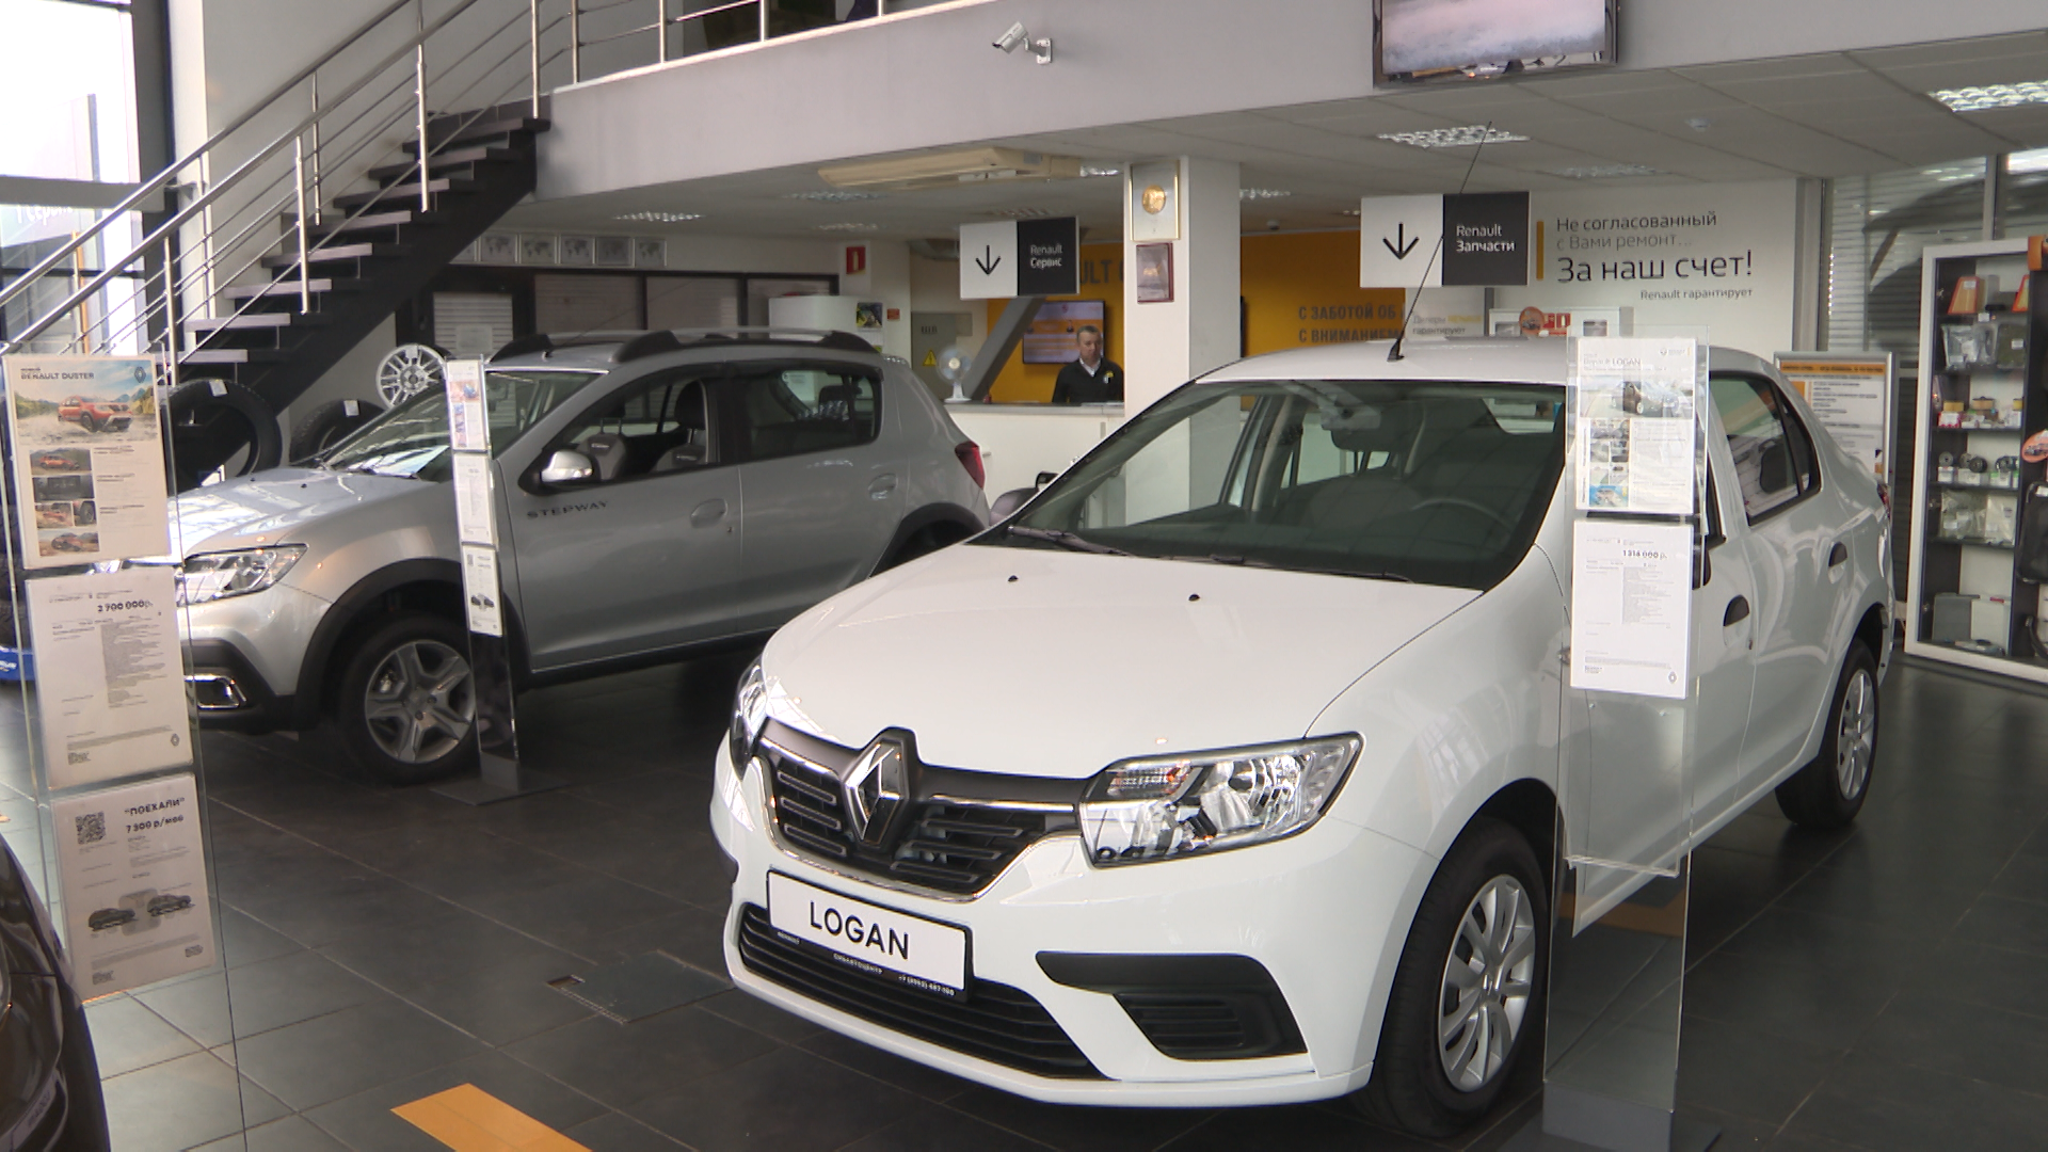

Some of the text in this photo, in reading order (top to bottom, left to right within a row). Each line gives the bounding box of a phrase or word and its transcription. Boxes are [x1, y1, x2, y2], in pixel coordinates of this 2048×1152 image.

[1557, 211, 1717, 232] Не согласованный
[1456, 223, 1503, 237] Renault
[1456, 240, 1515, 252] Запчасти
[1557, 238, 1564, 250] с
[1569, 235, 1611, 250] Вами
[1030, 243, 1063, 256] Renault
[1030, 257, 1062, 270] Сервис
[1557, 249, 1752, 283] За наш счет!
[1640, 287, 1753, 300] Renault гарантирует
[1298, 302, 1396, 321] С ЗАБОТОЙ ОБ
[1298, 328, 1307, 343] С
[1612, 357, 1641, 366] LOGAN
[62, 372, 94, 380] DUSTER
[527, 500, 608, 519] STEPWAY
[105, 602, 123, 611] 700
[126, 825, 131, 833] 7
[810, 901, 909, 960] LOGAN
